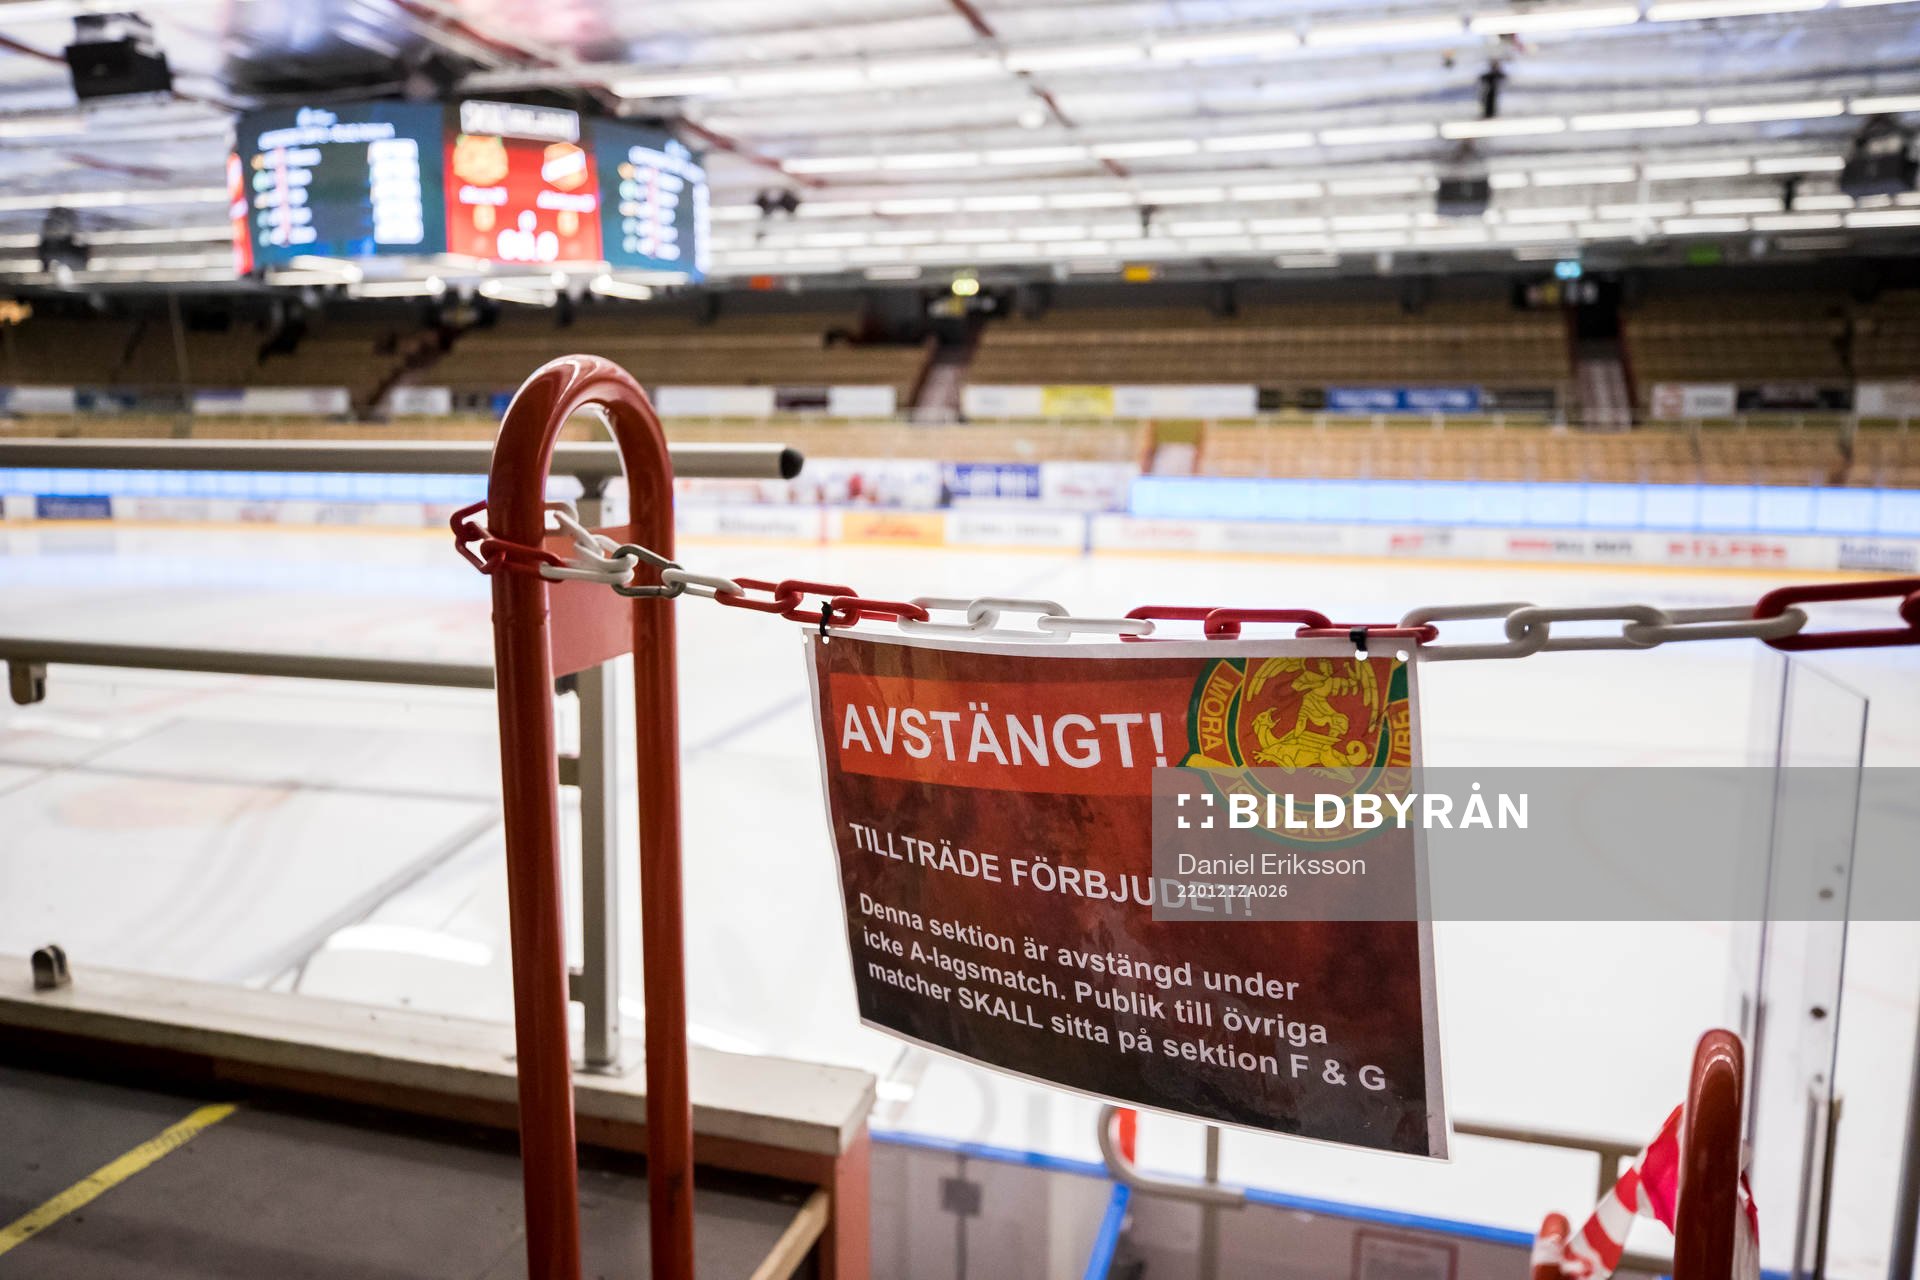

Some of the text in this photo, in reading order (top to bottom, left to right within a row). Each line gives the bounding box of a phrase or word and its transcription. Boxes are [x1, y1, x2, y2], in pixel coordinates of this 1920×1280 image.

[841, 701, 1168, 769] AVSTÄNGT!
[1201, 674, 1234, 751] MORA
[849, 822, 1252, 917] TILLTRÄDE FÖRBJUDET!
[859, 892, 1300, 1001] Denna sektion är avstängd under
[863, 925, 1328, 1047] icke A-lagsmatch. Publik till övriga
[868, 962, 1386, 1092] matcher SKALL sitta på sektion F & G
